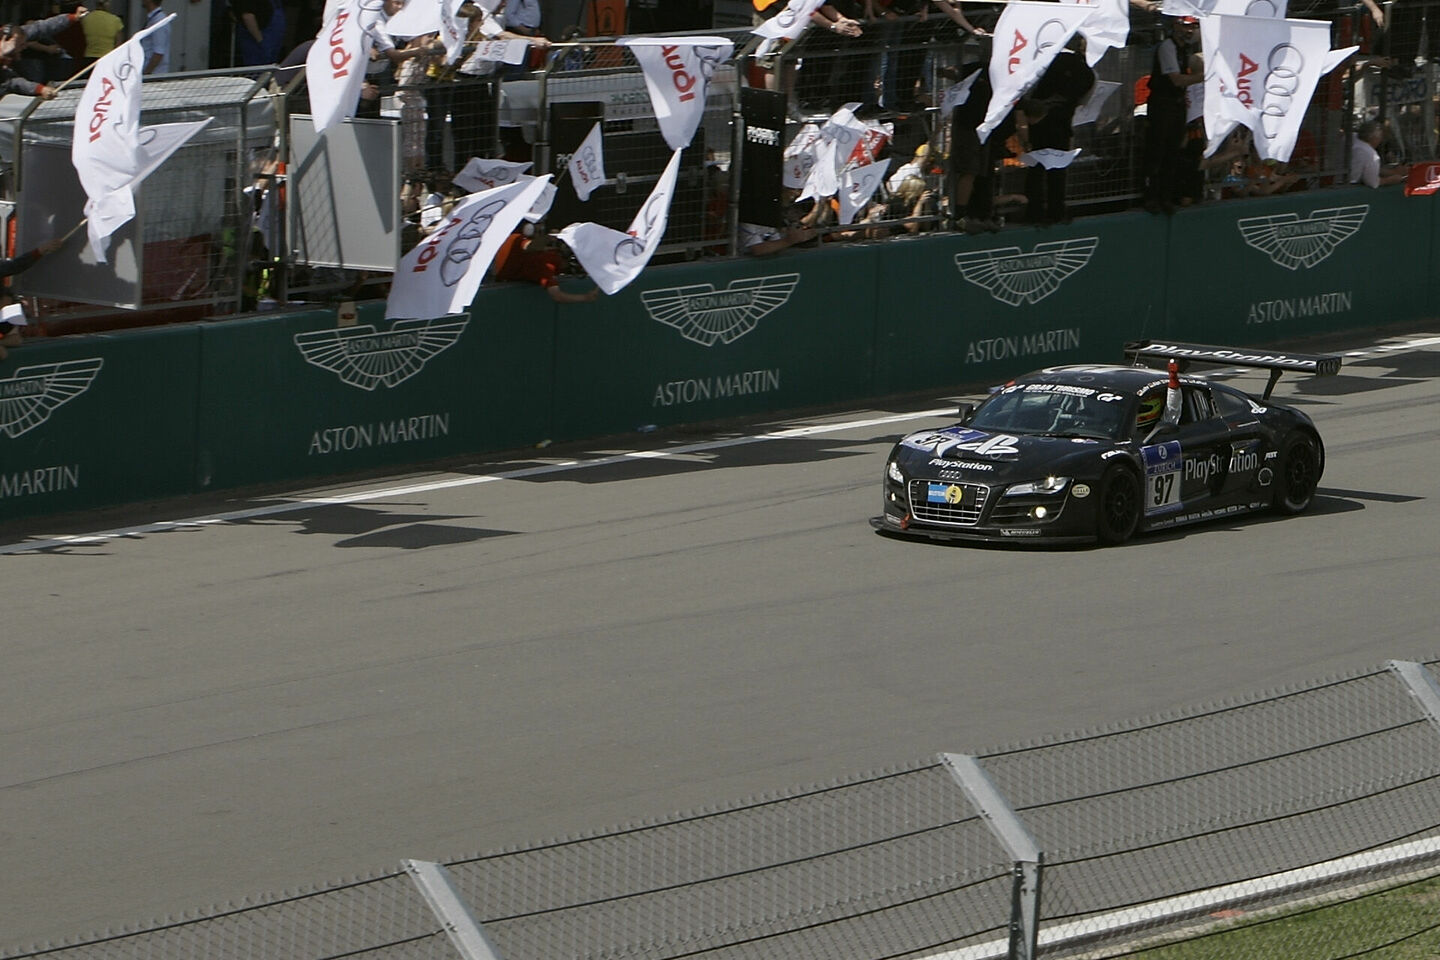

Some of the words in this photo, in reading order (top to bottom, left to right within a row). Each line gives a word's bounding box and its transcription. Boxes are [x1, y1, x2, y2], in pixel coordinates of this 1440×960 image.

[329, 12, 351, 80] Audi
[88, 76, 117, 143] Audi
[688, 295, 717, 310] ASTON
[718, 291, 753, 307] MARTIN
[1247, 300, 1296, 325] ASTON
[1299, 291, 1353, 317] MARTIN
[347, 338, 380, 355] ASTON
[381, 333, 419, 351] MARTIN
[965, 336, 1019, 364] ASTON
[1021, 327, 1081, 356] MARTIN
[1141, 343, 1317, 368] PlayStation
[3, 379, 45, 397] MARTIN
[653, 377, 711, 408] ASTON
[715, 368, 780, 398] MARTIN
[1026, 384, 1051, 392] GRAN
[1052, 384, 1095, 395] TURISMO
[308, 424, 373, 455] ASTON
[377, 412, 450, 446] MARTIN
[0, 463, 80, 499] MARTIN
[928, 458, 994, 471] PlayStation
[1153, 473, 1175, 506] 97
